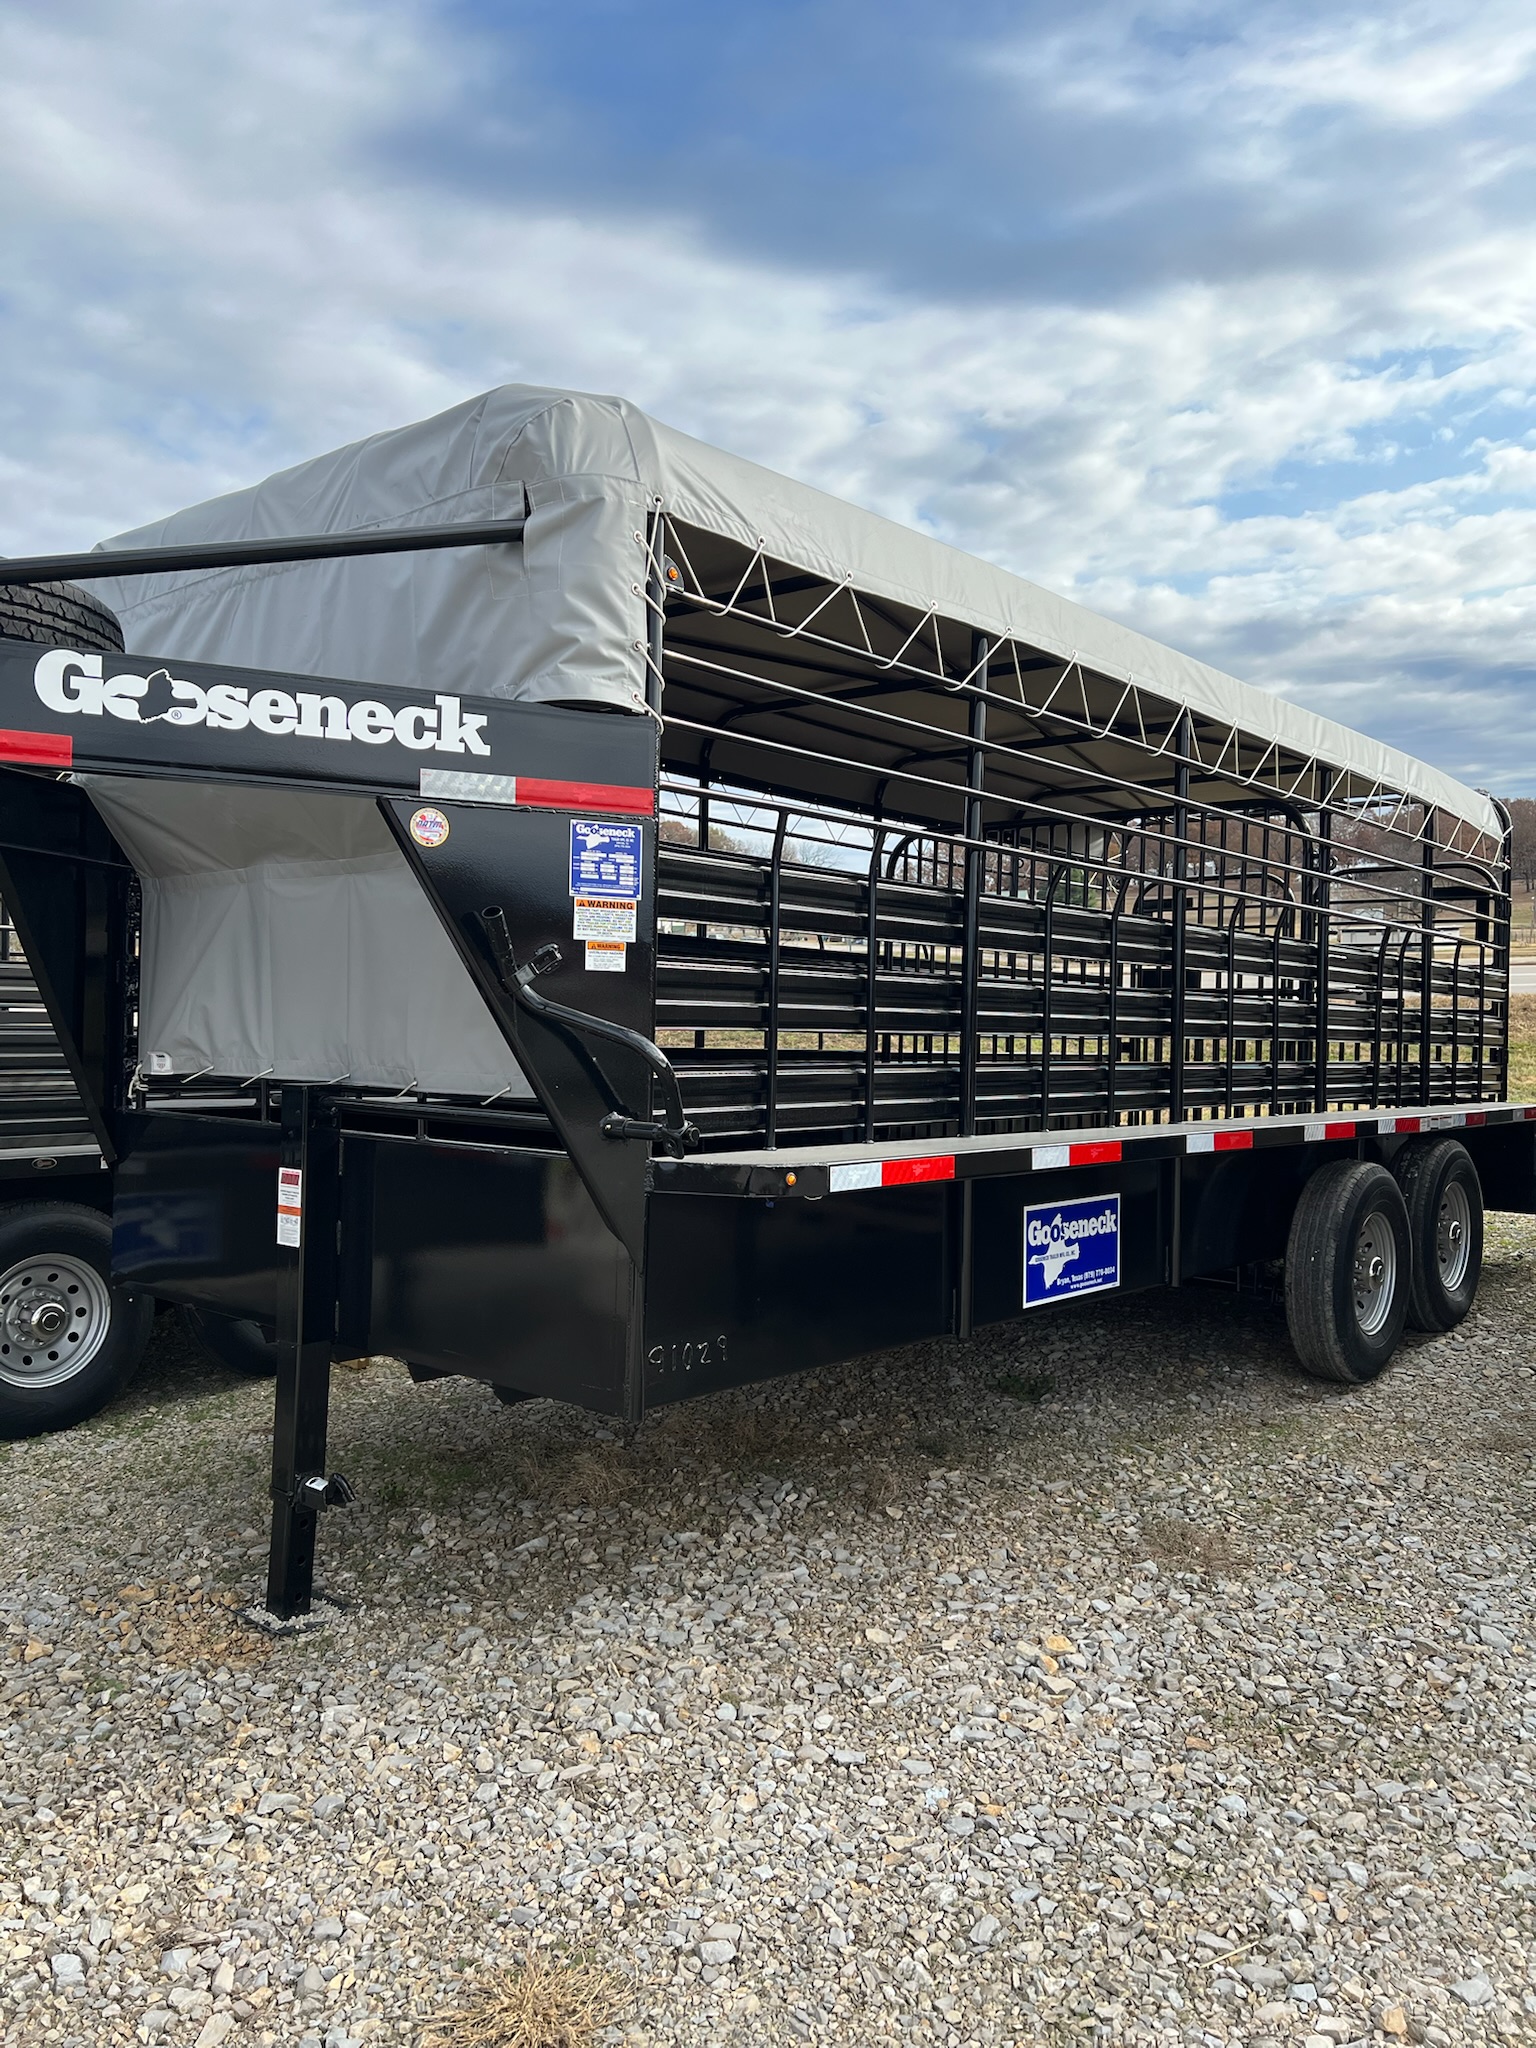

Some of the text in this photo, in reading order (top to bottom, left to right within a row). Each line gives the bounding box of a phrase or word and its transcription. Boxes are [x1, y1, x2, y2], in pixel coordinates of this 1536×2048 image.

[34, 648, 491, 756] Gooseneck
[575, 823, 636, 838] Gooseneck
[587, 900, 633, 910] WARNING
[1028, 1209, 1118, 1247] Gooseneck
[1071, 1274, 1083, 1282] Texas
[648, 1335, 728, 1373] 91029
